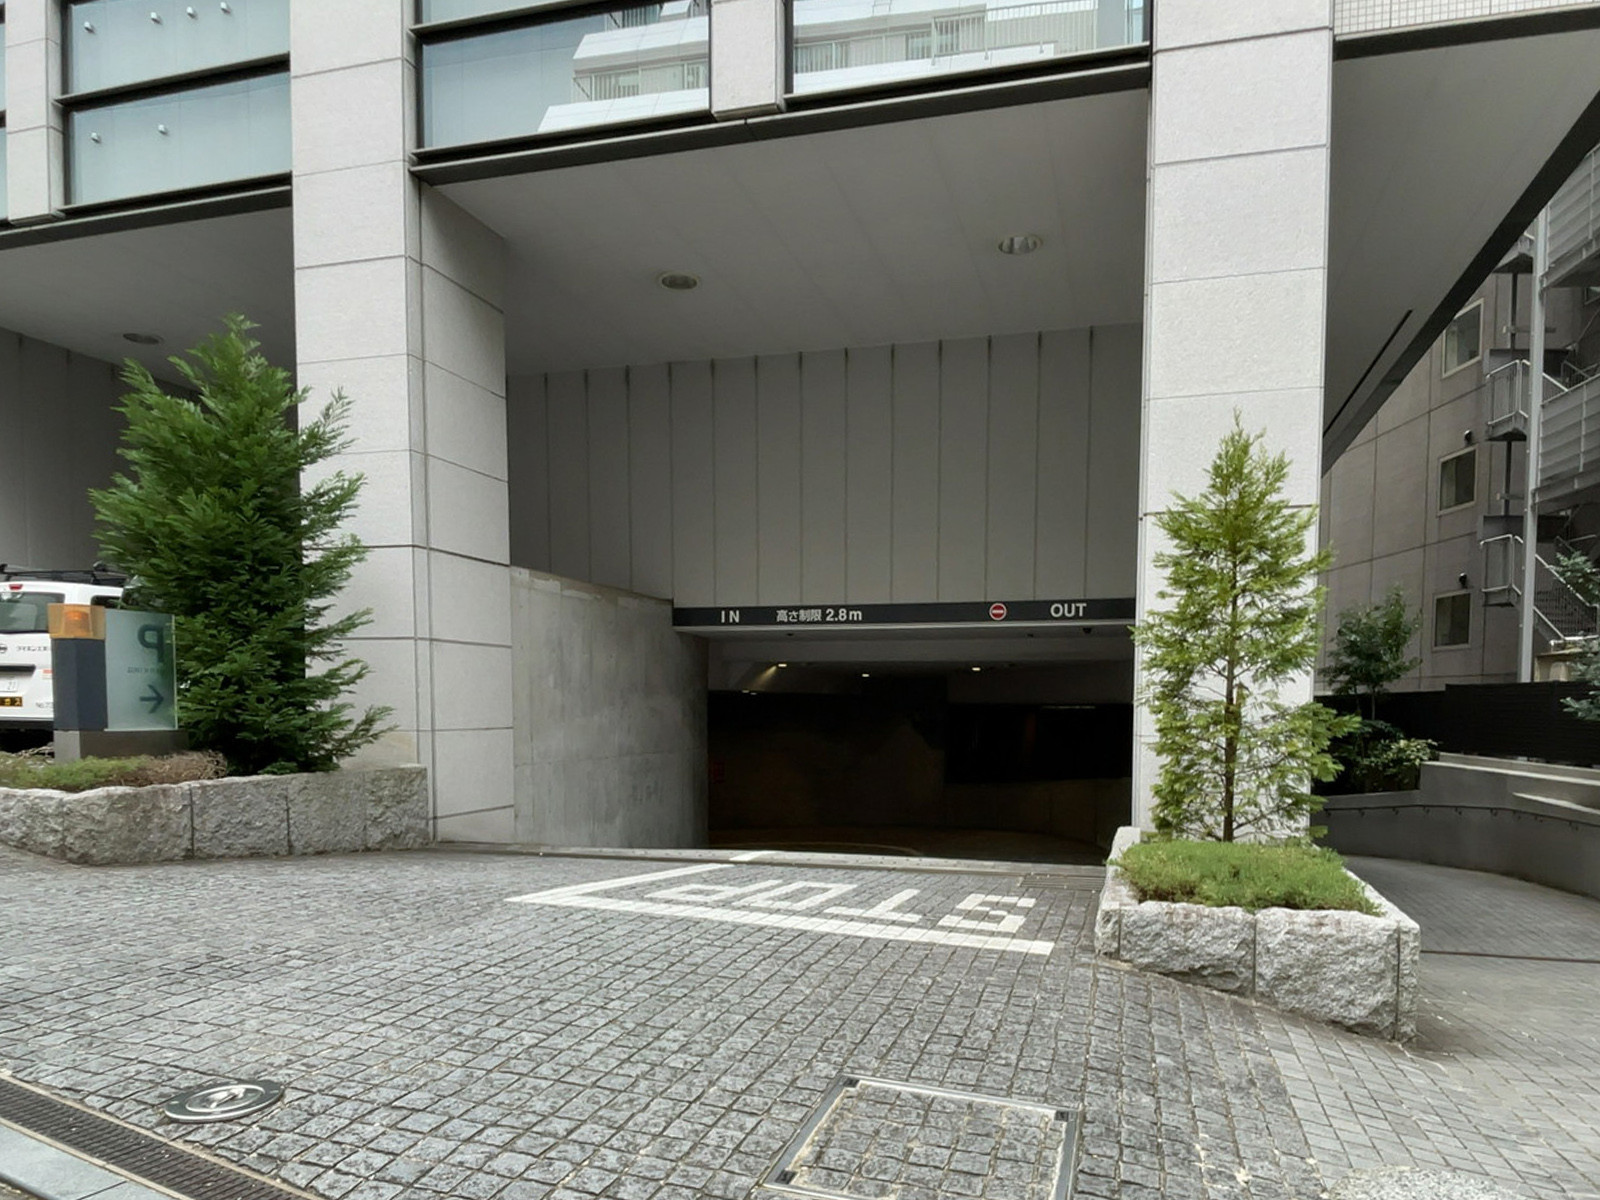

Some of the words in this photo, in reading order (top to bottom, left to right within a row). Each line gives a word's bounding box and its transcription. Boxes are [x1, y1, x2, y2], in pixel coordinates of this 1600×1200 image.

[720, 610, 740, 623] IN
[776, 608, 822, 623] 高さ制限
[825, 607, 863, 622] 2.8m
[1050, 602, 1087, 618] OUT
[644, 880, 1037, 933] STOP
